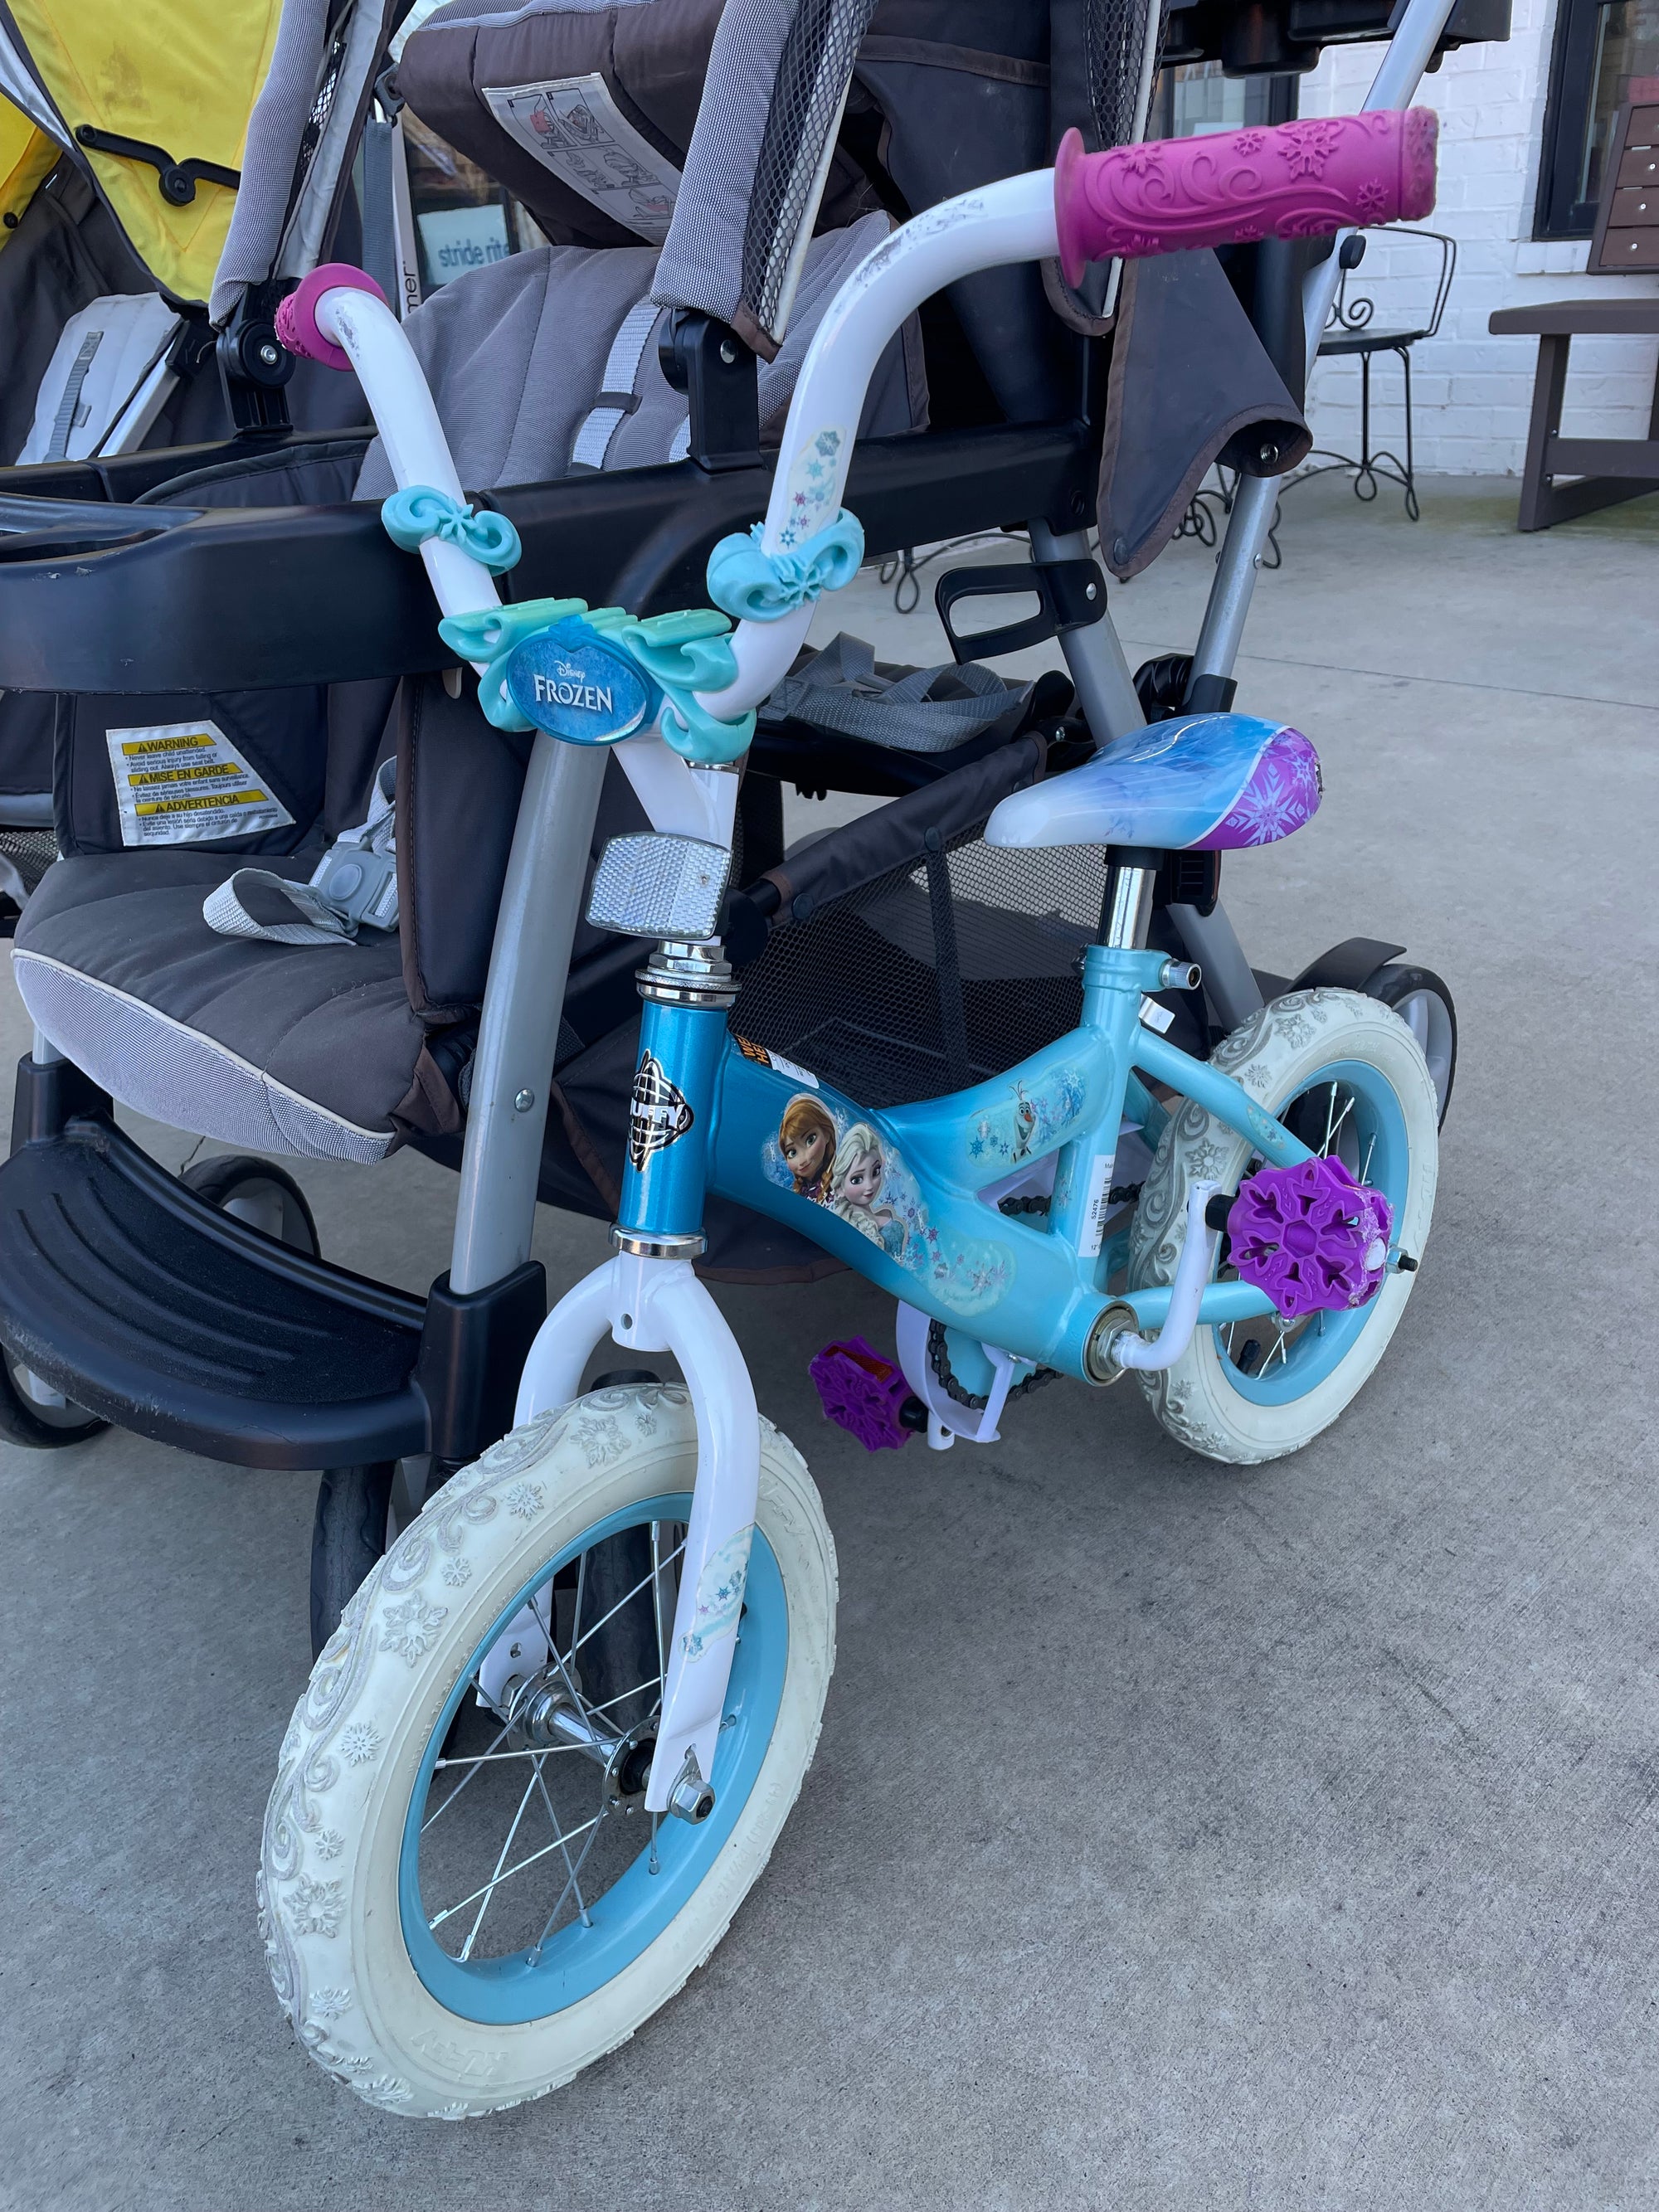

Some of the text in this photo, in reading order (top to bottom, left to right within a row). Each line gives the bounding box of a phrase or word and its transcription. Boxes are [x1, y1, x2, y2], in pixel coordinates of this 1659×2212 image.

[438, 238, 484, 267] stride
[554, 660, 585, 683] Disney
[533, 673, 613, 715] FROZEN
[147, 737, 198, 751] WARNING
[176, 746, 207, 756] unattended.
[149, 764, 230, 783] MISE EN GARDE
[167, 794, 239, 812] ADVERTENCIA
[193, 808, 225, 817] desatendido.
